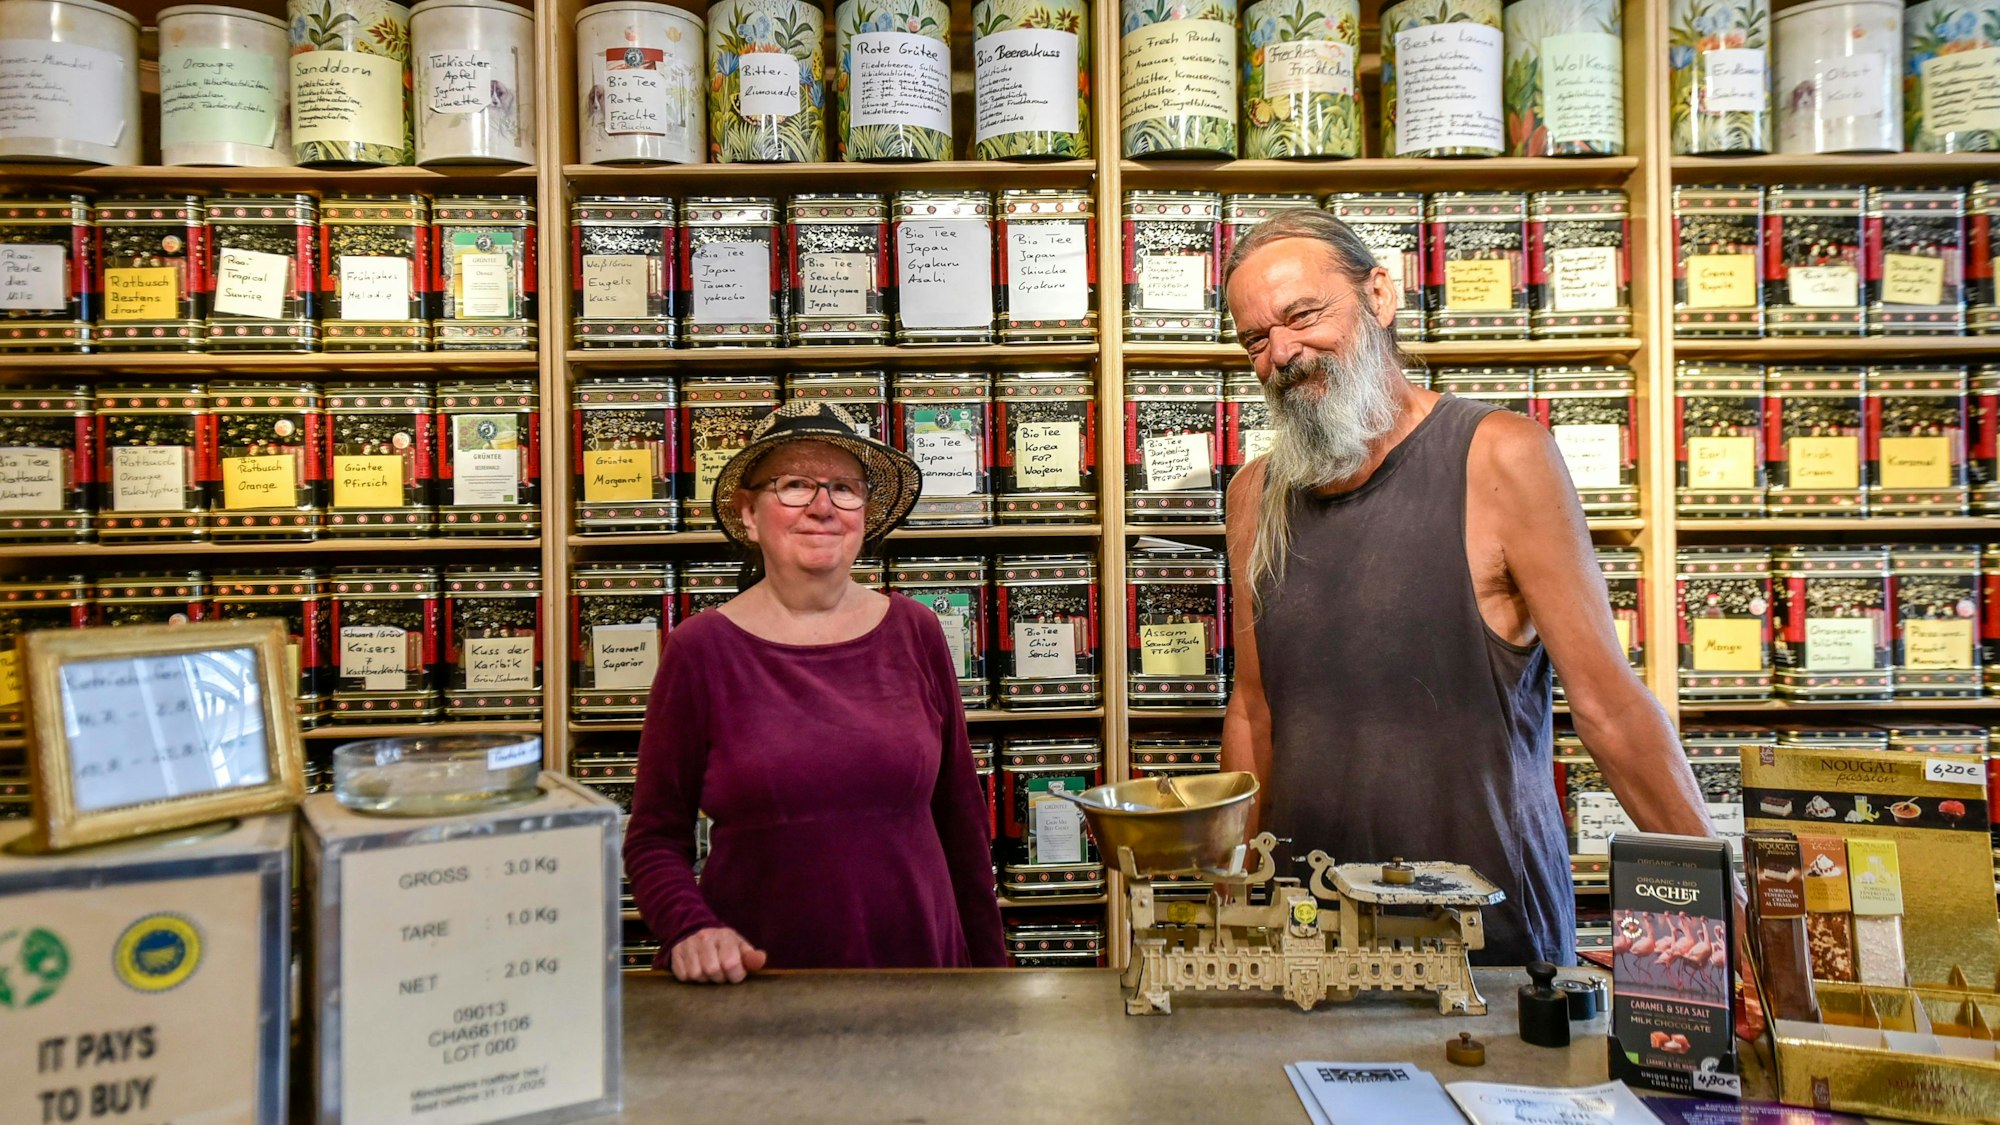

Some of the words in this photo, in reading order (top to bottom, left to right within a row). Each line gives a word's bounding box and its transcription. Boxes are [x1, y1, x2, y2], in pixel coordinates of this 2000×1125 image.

[1146, 33, 1179, 48] Fresh
[1400, 34, 1446, 51] Beste
[857, 41, 890, 55] Rote
[899, 42, 938, 61] Grütze
[976, 50, 993, 68] Bio
[995, 43, 1060, 60] Beerenkuss
[183, 58, 235, 75] Orange
[296, 58, 372, 77] Sanddorn
[429, 55, 490, 68] Türkischer
[443, 71, 476, 81] Apfel
[742, 64, 788, 76] Bitter-
[607, 77, 628, 87] Bio
[633, 76, 656, 88] Tee
[435, 97, 482, 108] Limette
[608, 94, 643, 104] Rote
[611, 112, 657, 121] Früchte
[901, 226, 925, 239] Bio
[928, 225, 958, 238] Tee
[1013, 234, 1038, 246] Bio
[1045, 233, 1073, 244] Tee
[699, 249, 719, 259] Bio
[724, 246, 745, 257] Tee
[906, 243, 949, 256] Japan
[807, 257, 825, 268] Bio
[830, 256, 853, 268] Tee
[1019, 250, 1056, 263] Japan
[5, 261, 42, 273] Perle
[907, 257, 960, 271] Gyokuru
[225, 268, 268, 284] Tropical
[702, 265, 737, 277] Japan
[808, 272, 850, 282] Sencha
[1020, 266, 1068, 276] Shincha
[110, 275, 169, 287] Rotbusch
[588, 278, 632, 291] Engels
[907, 274, 946, 285] Asahi
[809, 285, 860, 296] Uchiyama
[1018, 281, 1066, 293] Gyokuru
[110, 292, 161, 303] Bestens
[224, 287, 264, 302] Sunrise
[347, 291, 393, 300] Melodie
[110, 304, 146, 315] drauf
[808, 299, 840, 310] Japan
[1020, 427, 1039, 438] Bio
[1041, 426, 1061, 437] Tee
[916, 437, 936, 448] Bio
[939, 436, 962, 447] Tee
[1025, 441, 1058, 452] Korea
[1146, 439, 1163, 449] Bio
[1165, 437, 1182, 446] Tee
[473, 453, 502, 461] GRÜNTEE
[699, 452, 714, 461] Bio
[1150, 446, 1191, 458] Darjeeling
[23, 454, 50, 467] Tee
[116, 456, 176, 468] Rotbusch
[596, 456, 634, 465] Grüntee
[917, 453, 953, 466] Japan
[238, 463, 283, 473] Rotbusch
[345, 462, 383, 472] Grüntee
[1024, 465, 1063, 478] Woojeon
[120, 472, 161, 484] Orange
[343, 475, 388, 489] Pfirsich
[593, 474, 643, 489] Morgenrot
[121, 485, 180, 498] Eukalyptus
[238, 481, 277, 493] Orange
[1024, 627, 1040, 637] Bio
[1041, 626, 1058, 636] Tee
[1144, 628, 1187, 638] Assam
[347, 642, 396, 653] Kaisers
[602, 642, 646, 654] Karamell
[1029, 638, 1057, 648] China
[1145, 640, 1172, 648] Second
[1176, 636, 1200, 645] Flush
[1704, 638, 1743, 654] Mango
[471, 644, 500, 656] Kuss
[507, 644, 531, 656] der
[1028, 650, 1059, 659] Sencha
[474, 658, 522, 669] Karibik
[602, 658, 644, 672] Superior
[1821, 759, 1898, 774] NOUGAT
[1932, 763, 1981, 778] 6,20€
[1836, 771, 1897, 786] passion
[1580, 797, 1600, 808] Bio
[1581, 815, 1626, 830] English
[1758, 842, 1797, 850] NOUGAT
[1637, 858, 1675, 867] ORGANIC
[399, 866, 470, 889] GROSS
[504, 859, 530, 876] 3.0
[535, 856, 559, 874] Kg
[1637, 877, 1674, 886] ORGANIC
[1682, 880, 1697, 888] BIO
[1635, 884, 1700, 905] CACHET
[399, 921, 450, 942] TARE
[507, 910, 530, 926] 1.0
[535, 907, 559, 924] Kg
[399, 974, 439, 995] NET
[504, 962, 530, 978] 2.0
[535, 958, 559, 974] Kg
[453, 1001, 507, 1024] 09013
[1630, 1000, 1664, 1013] CARAMEL
[1666, 1005, 1673, 1013] &
[1675, 1005, 1690, 1016] SEA
[1692, 1008, 1711, 1019] SALT
[1630, 1016, 1653, 1026] MILK
[1654, 1019, 1712, 1034] CHOCOLATE
[428, 1016, 530, 1047] CHA661106
[38, 1036, 68, 1074] IT
[77, 1024, 156, 1069] PAYS
[443, 1044, 480, 1065] LOT
[485, 1037, 516, 1056] 000
[1641, 1071, 1669, 1080] UNIQUE
[1651, 1080, 1693, 1091] CHOCOLATE
[38, 1088, 81, 1123] TO
[91, 1076, 156, 1117] BUY
